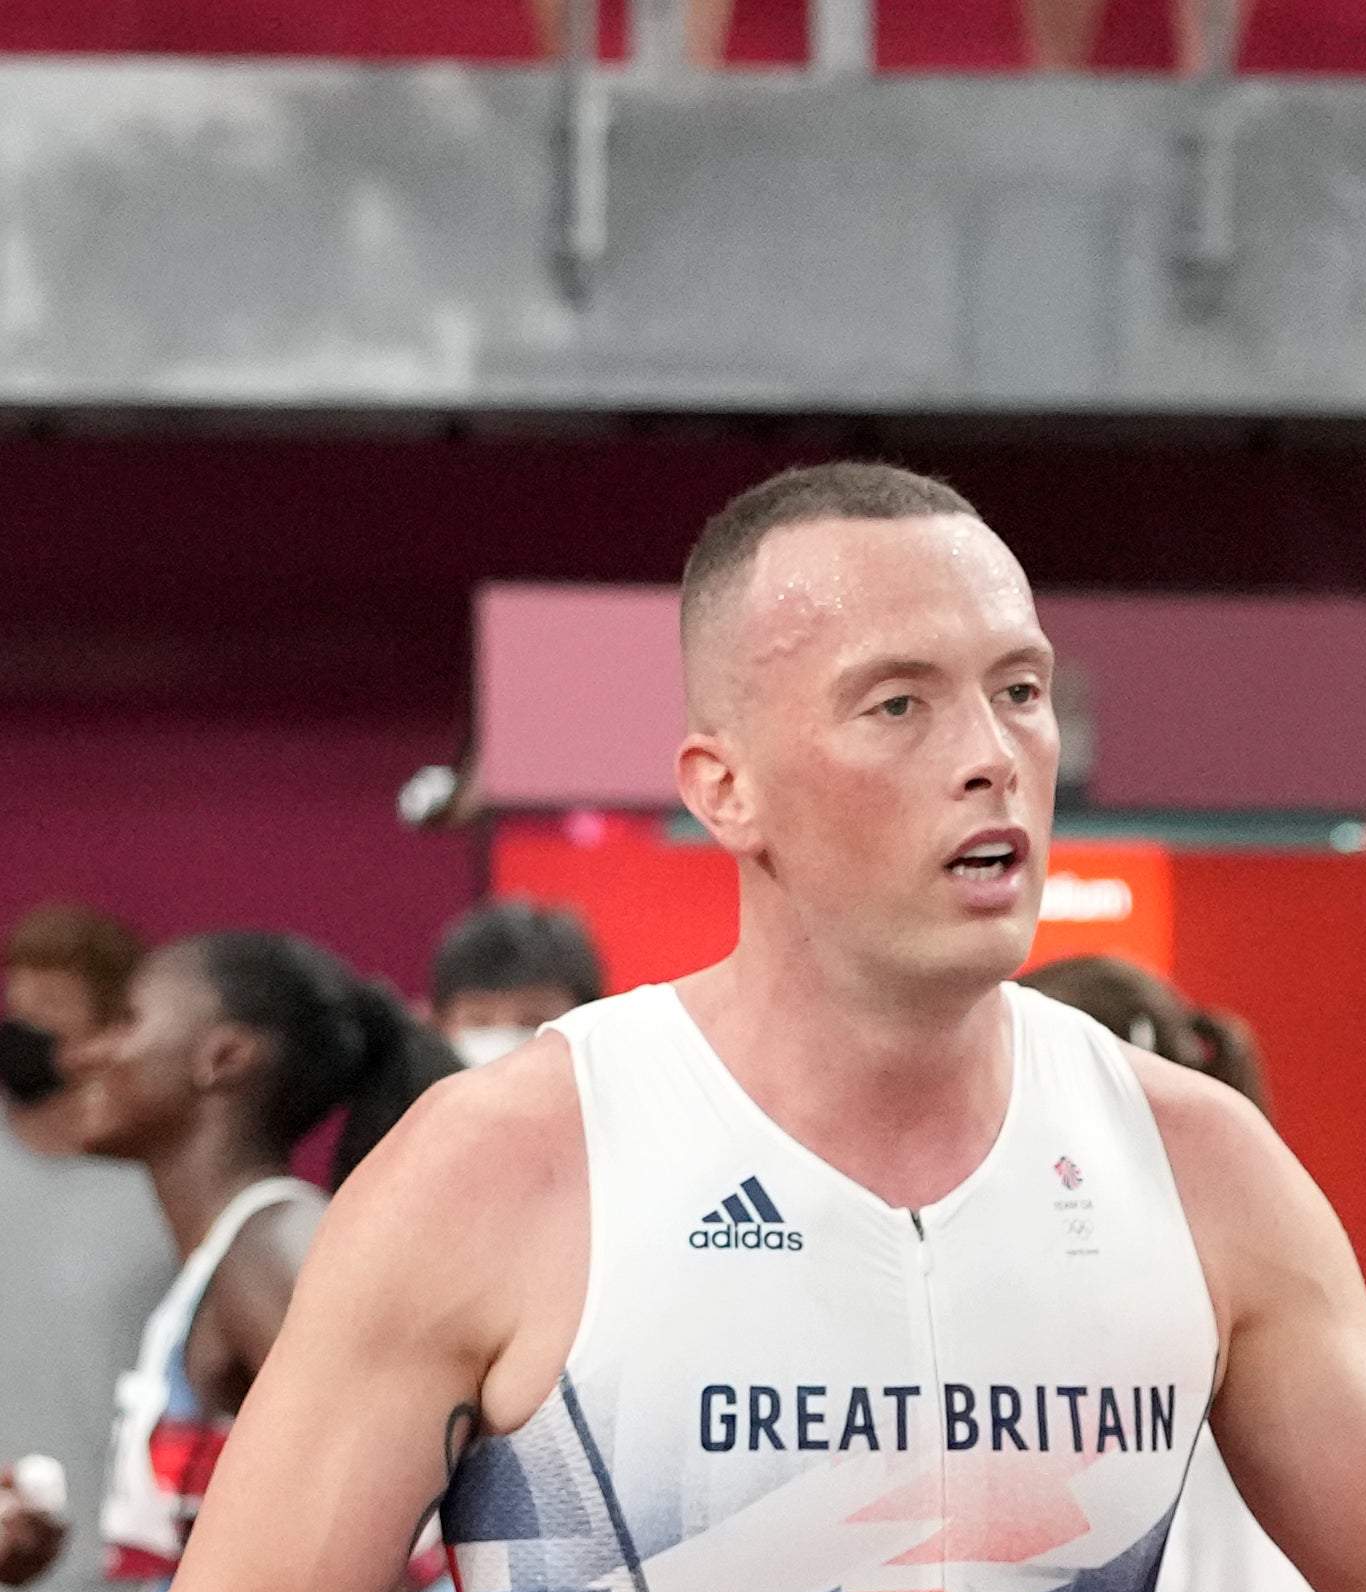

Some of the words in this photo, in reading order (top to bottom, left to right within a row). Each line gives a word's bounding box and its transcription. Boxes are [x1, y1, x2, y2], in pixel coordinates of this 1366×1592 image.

[689, 1224, 804, 1251] adidas
[700, 1383, 920, 1453] GREAT
[943, 1382, 1177, 1453] BRITAIN
